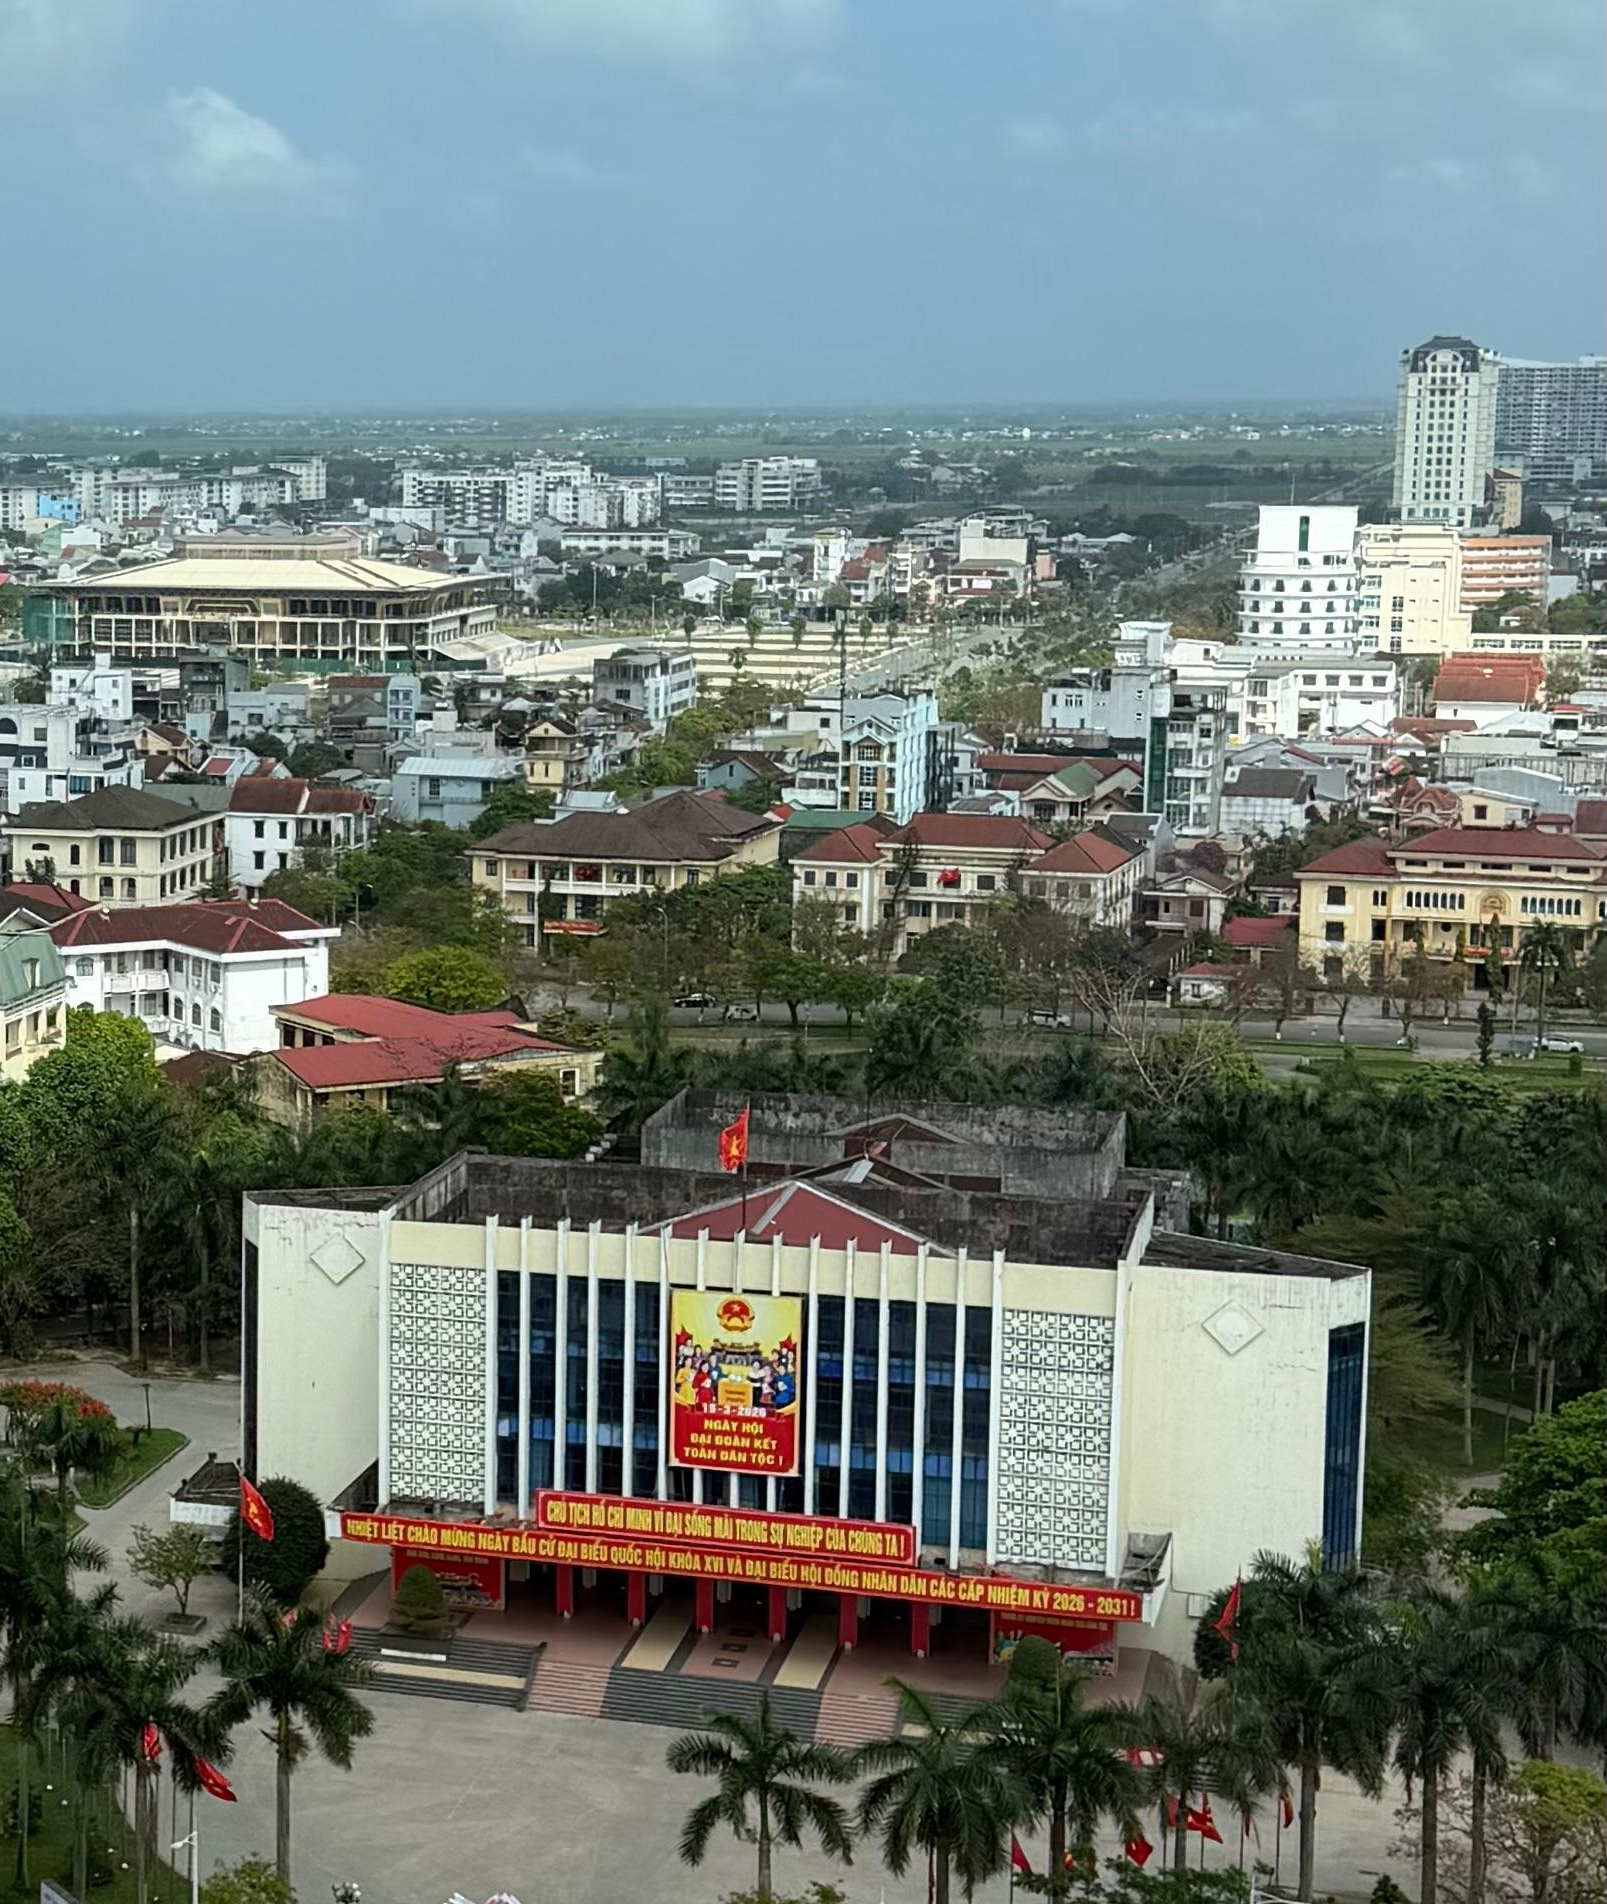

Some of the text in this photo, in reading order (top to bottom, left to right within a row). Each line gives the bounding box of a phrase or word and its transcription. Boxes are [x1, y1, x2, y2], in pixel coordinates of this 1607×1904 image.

[704, 1419, 763, 1435] NGÀY HỘI
[690, 1433, 777, 1450] ĐẠI ĐOÀN KẾT
[684, 1446, 716, 1460] TOÀN
[720, 1450, 747, 1463] DÂN
[751, 1452, 775, 1466] TỘC
[547, 1497, 567, 1523] CHỦ
[569, 1502, 590, 1527] TỊCH
[592, 1498, 606, 1526] HỒ
[607, 1503, 624, 1529] CHÍ
[626, 1507, 652, 1531] MINH
[654, 1507, 664, 1532] VĨ
[666, 1512, 682, 1538] ĐẠI
[685, 1508, 712, 1537] SỐNG
[714, 1514, 733, 1540] MÃI
[735, 1519, 768, 1544] TRONG
[770, 1522, 784, 1549] SỰ
[787, 1522, 823, 1552] NGHIỆP
[826, 1524, 846, 1551] CỦA
[848, 1527, 882, 1555] CHÚNG
[885, 1534, 898, 1556] TA
[347, 1518, 379, 1541] NHIỆT
[407, 1523, 438, 1545] CHÀO
[440, 1527, 476, 1548] MỪNG
[478, 1531, 510, 1552] NGÀY
[512, 1531, 536, 1555] BẦU
[539, 1534, 557, 1556] CỬ
[558, 1540, 578, 1562] ĐẠI
[581, 1538, 608, 1562] BIỂU
[610, 1542, 643, 1565] QUỐC
[646, 1548, 666, 1570] HỘI
[669, 1549, 701, 1572] KHÓA
[704, 1555, 723, 1573] XVI
[727, 1556, 743, 1575] VÀ
[746, 1559, 766, 1581] ĐẠI
[769, 1557, 797, 1579] BIỂU
[800, 1562, 822, 1587] HỘI
[825, 1564, 858, 1588] ĐỒNG
[862, 1570, 897, 1592] NHÂN
[900, 1574, 926, 1595] DÂN
[929, 1577, 955, 1599] CÁC
[958, 1577, 984, 1602] CẤP
[987, 1583, 1029, 1608] NHIỆM
[1053, 1592, 1085, 1612] 2026
